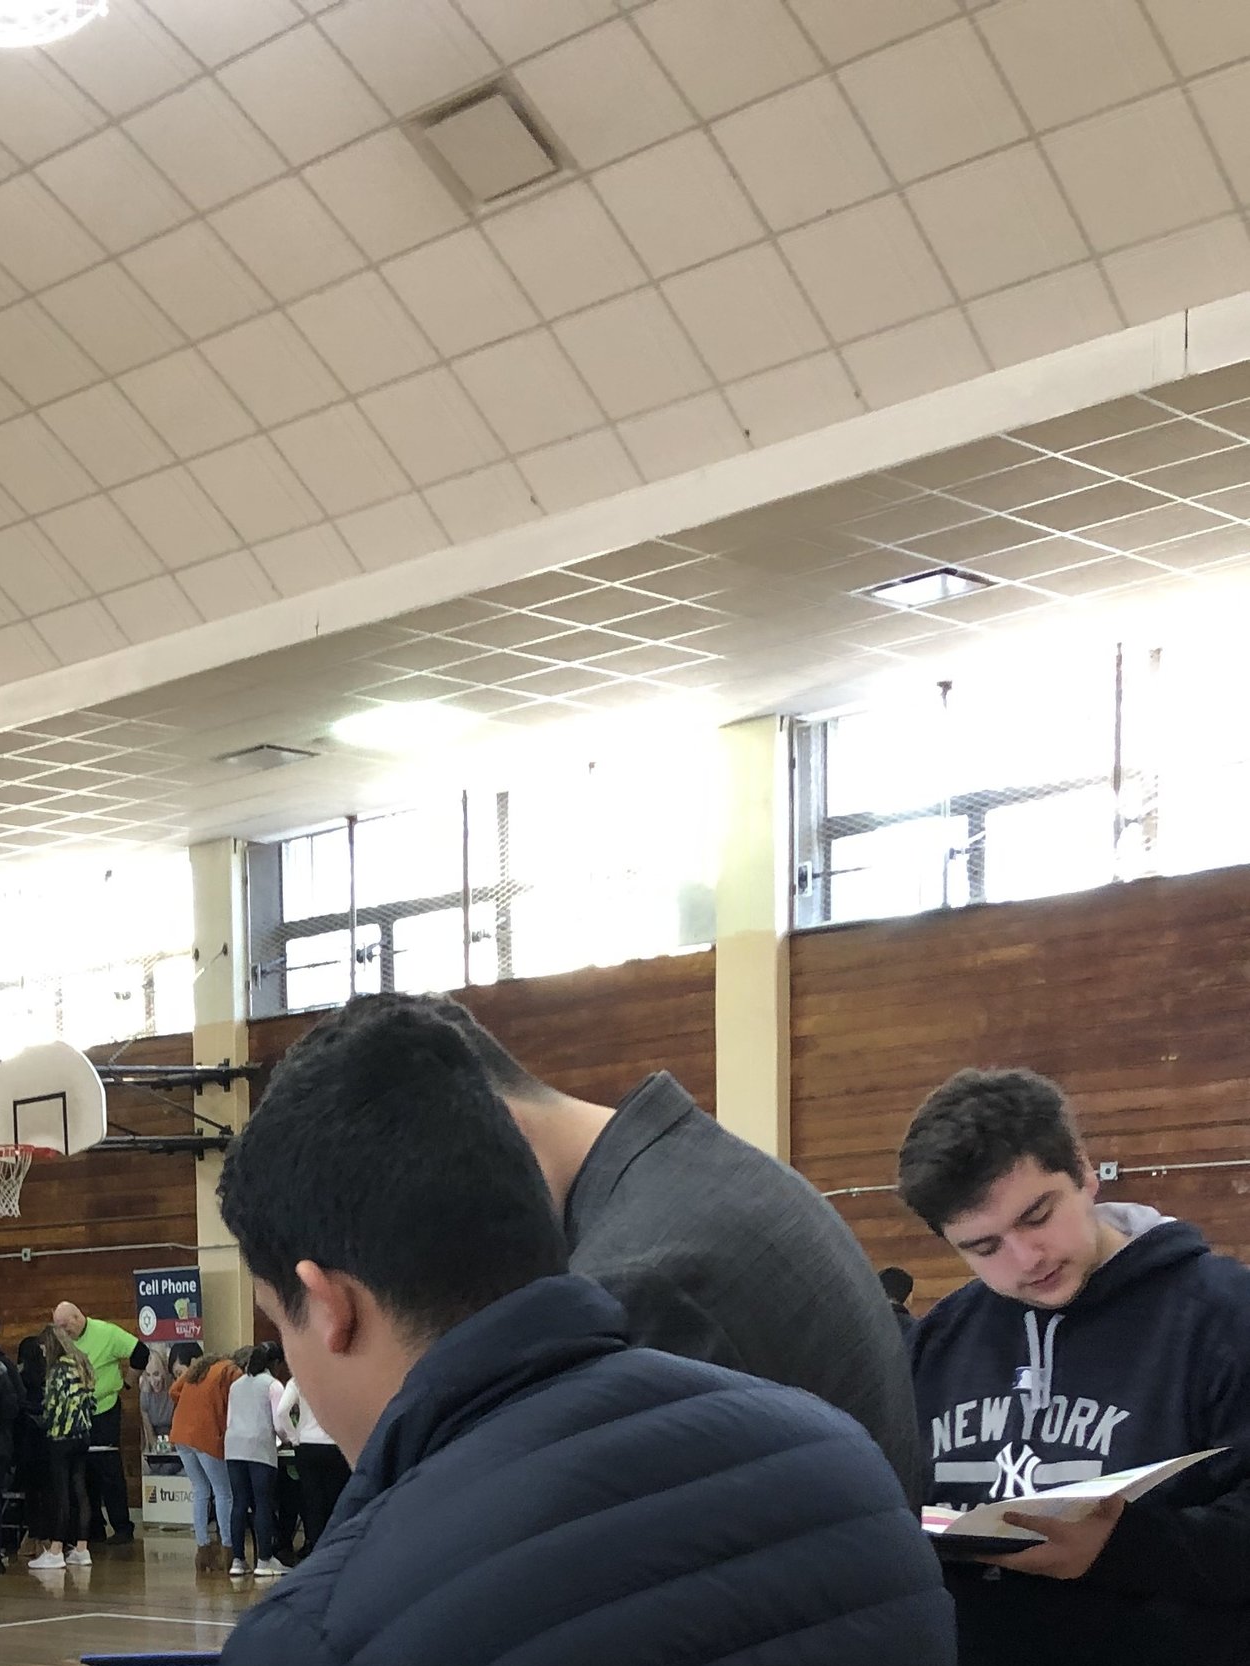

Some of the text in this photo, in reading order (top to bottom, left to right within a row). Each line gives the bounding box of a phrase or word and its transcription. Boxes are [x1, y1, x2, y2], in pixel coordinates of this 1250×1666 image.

[139, 1278, 197, 1296] Cell Phone
[932, 1394, 1131, 1459] NEW YORK
